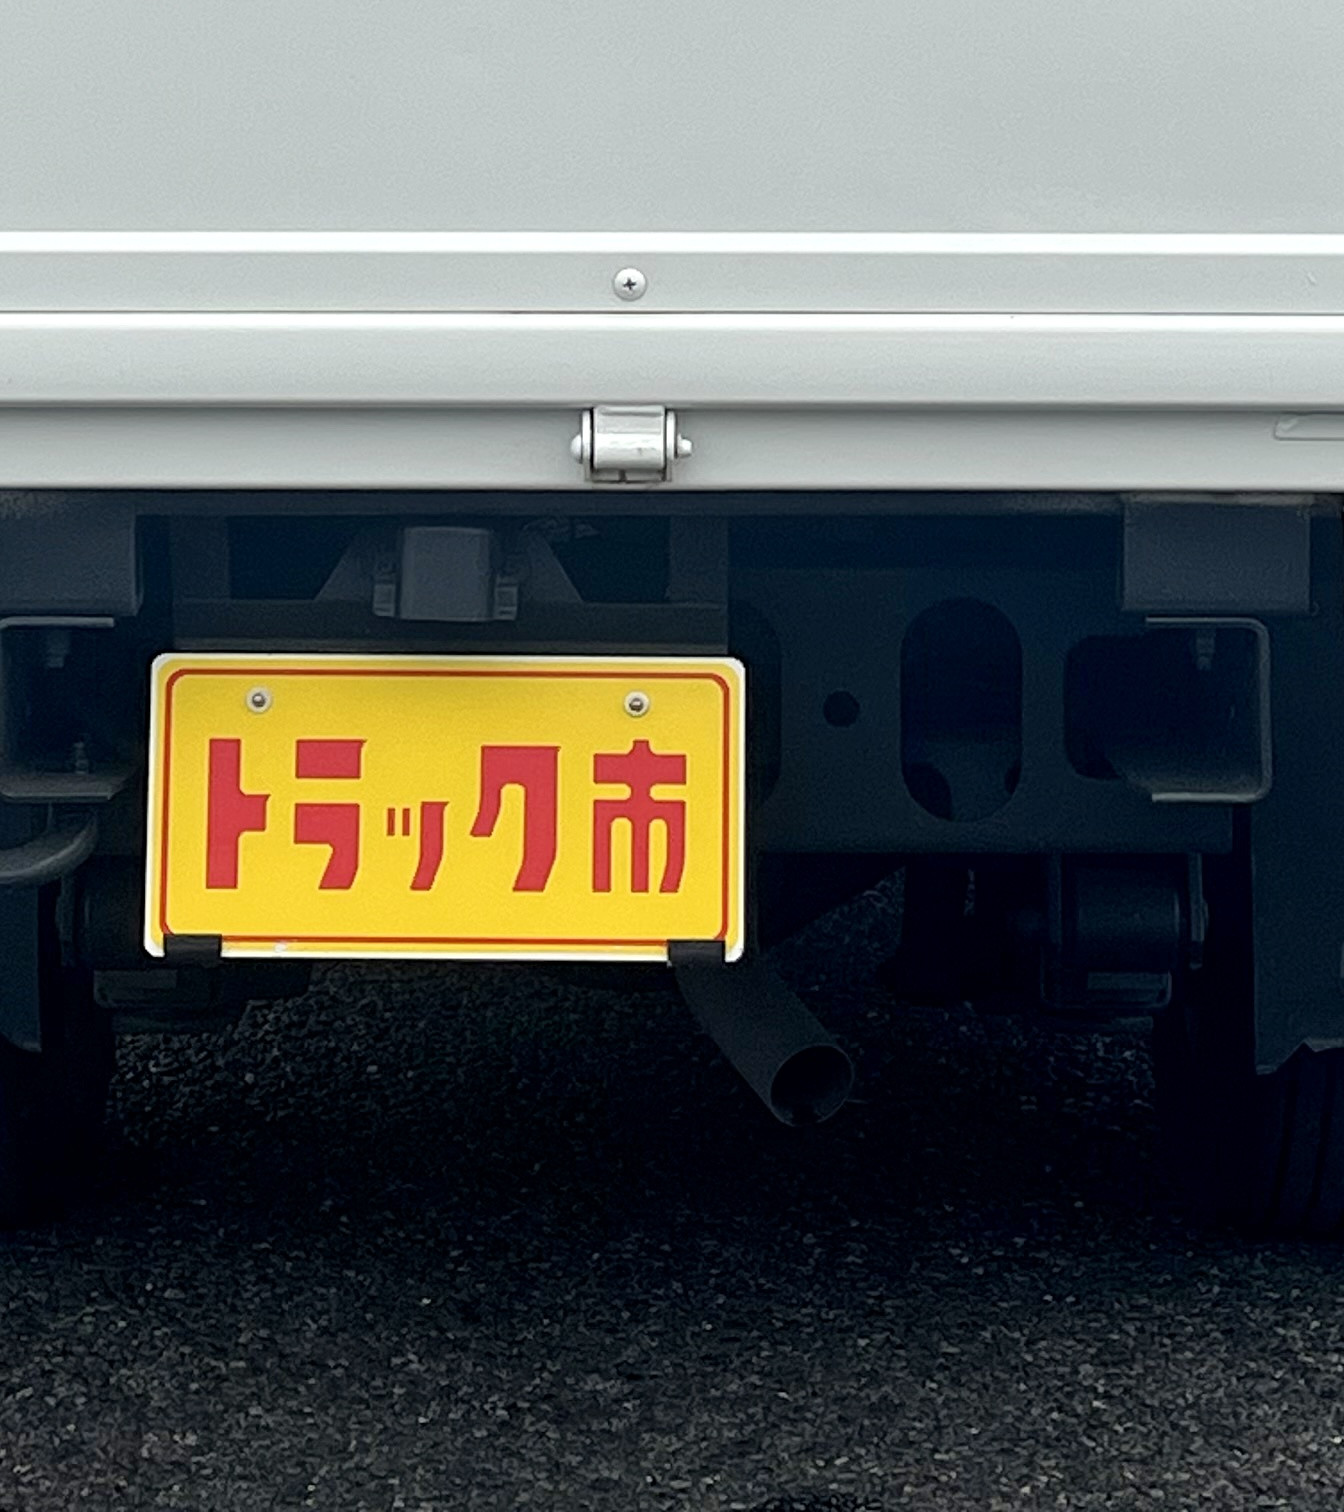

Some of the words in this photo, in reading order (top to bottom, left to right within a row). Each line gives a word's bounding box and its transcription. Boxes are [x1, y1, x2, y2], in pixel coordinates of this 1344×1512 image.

[205, 737, 687, 894] トラック市
